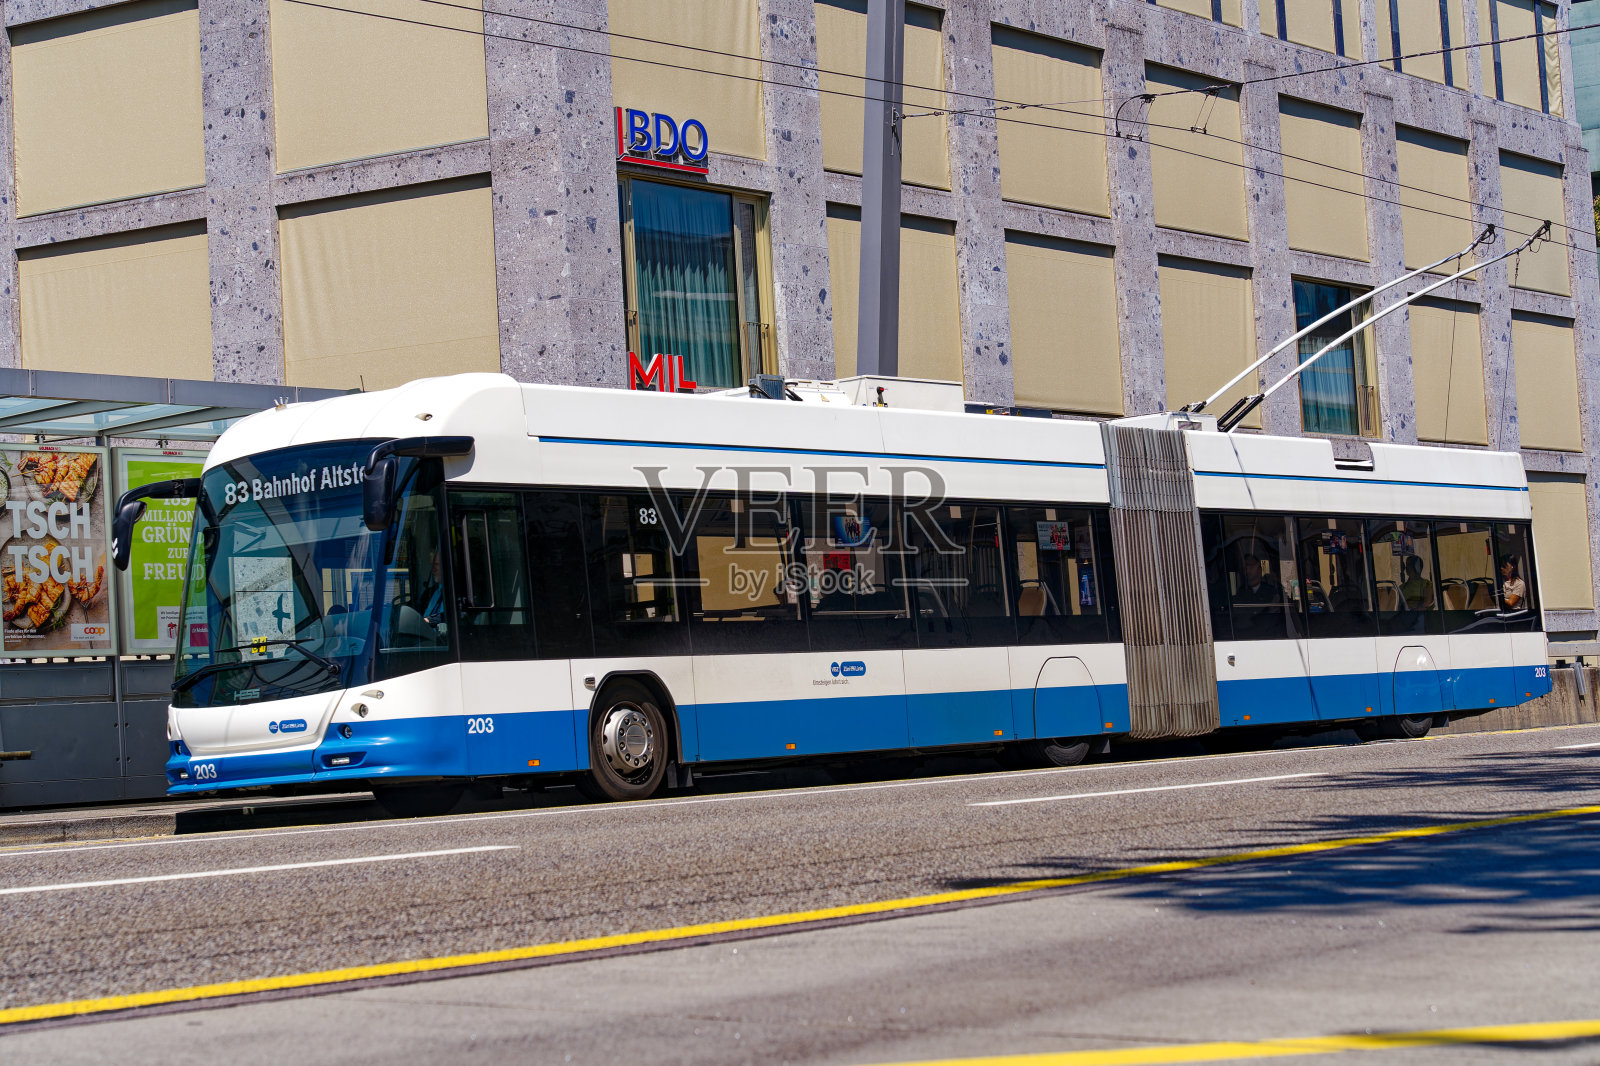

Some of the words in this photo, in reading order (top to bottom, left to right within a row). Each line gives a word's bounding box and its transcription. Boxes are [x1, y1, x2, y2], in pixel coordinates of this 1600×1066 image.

[626, 107, 709, 162] BDO
[627, 351, 697, 393] MIL
[224, 482, 250, 505] 83
[251, 468, 317, 501] Bahnhof
[5, 500, 91, 539] TSCH
[639, 508, 657, 525] 83
[8, 545, 94, 584] TSCH
[84, 627, 105, 636] coop
[1534, 667, 1546, 677] 203
[234, 688, 260, 701] HESS
[467, 717, 494, 734] 203
[194, 763, 217, 780] 203
